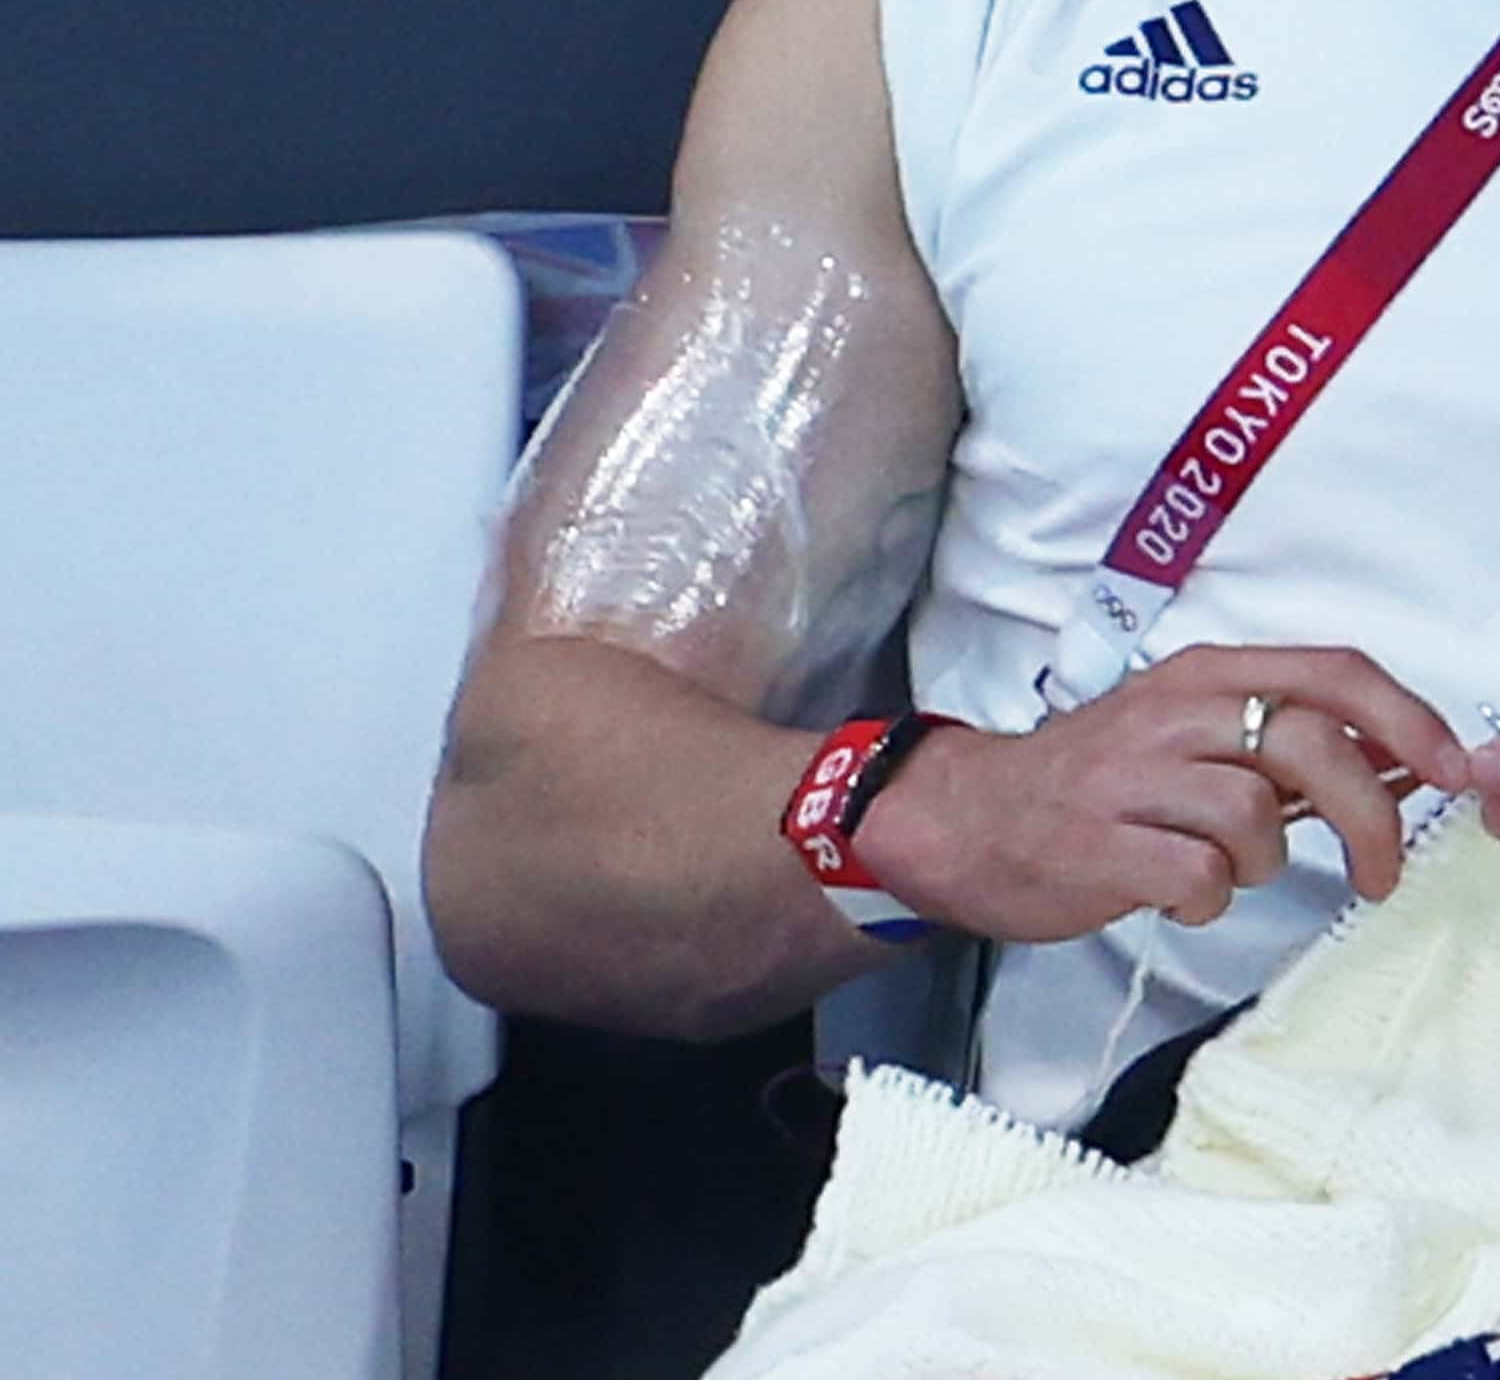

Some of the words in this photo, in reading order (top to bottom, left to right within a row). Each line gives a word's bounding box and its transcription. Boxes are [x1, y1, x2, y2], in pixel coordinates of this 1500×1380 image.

[1078, 57, 1259, 103] adidas
[1204, 322, 1333, 465] TOKYO
[1135, 457, 1223, 565] 2020
